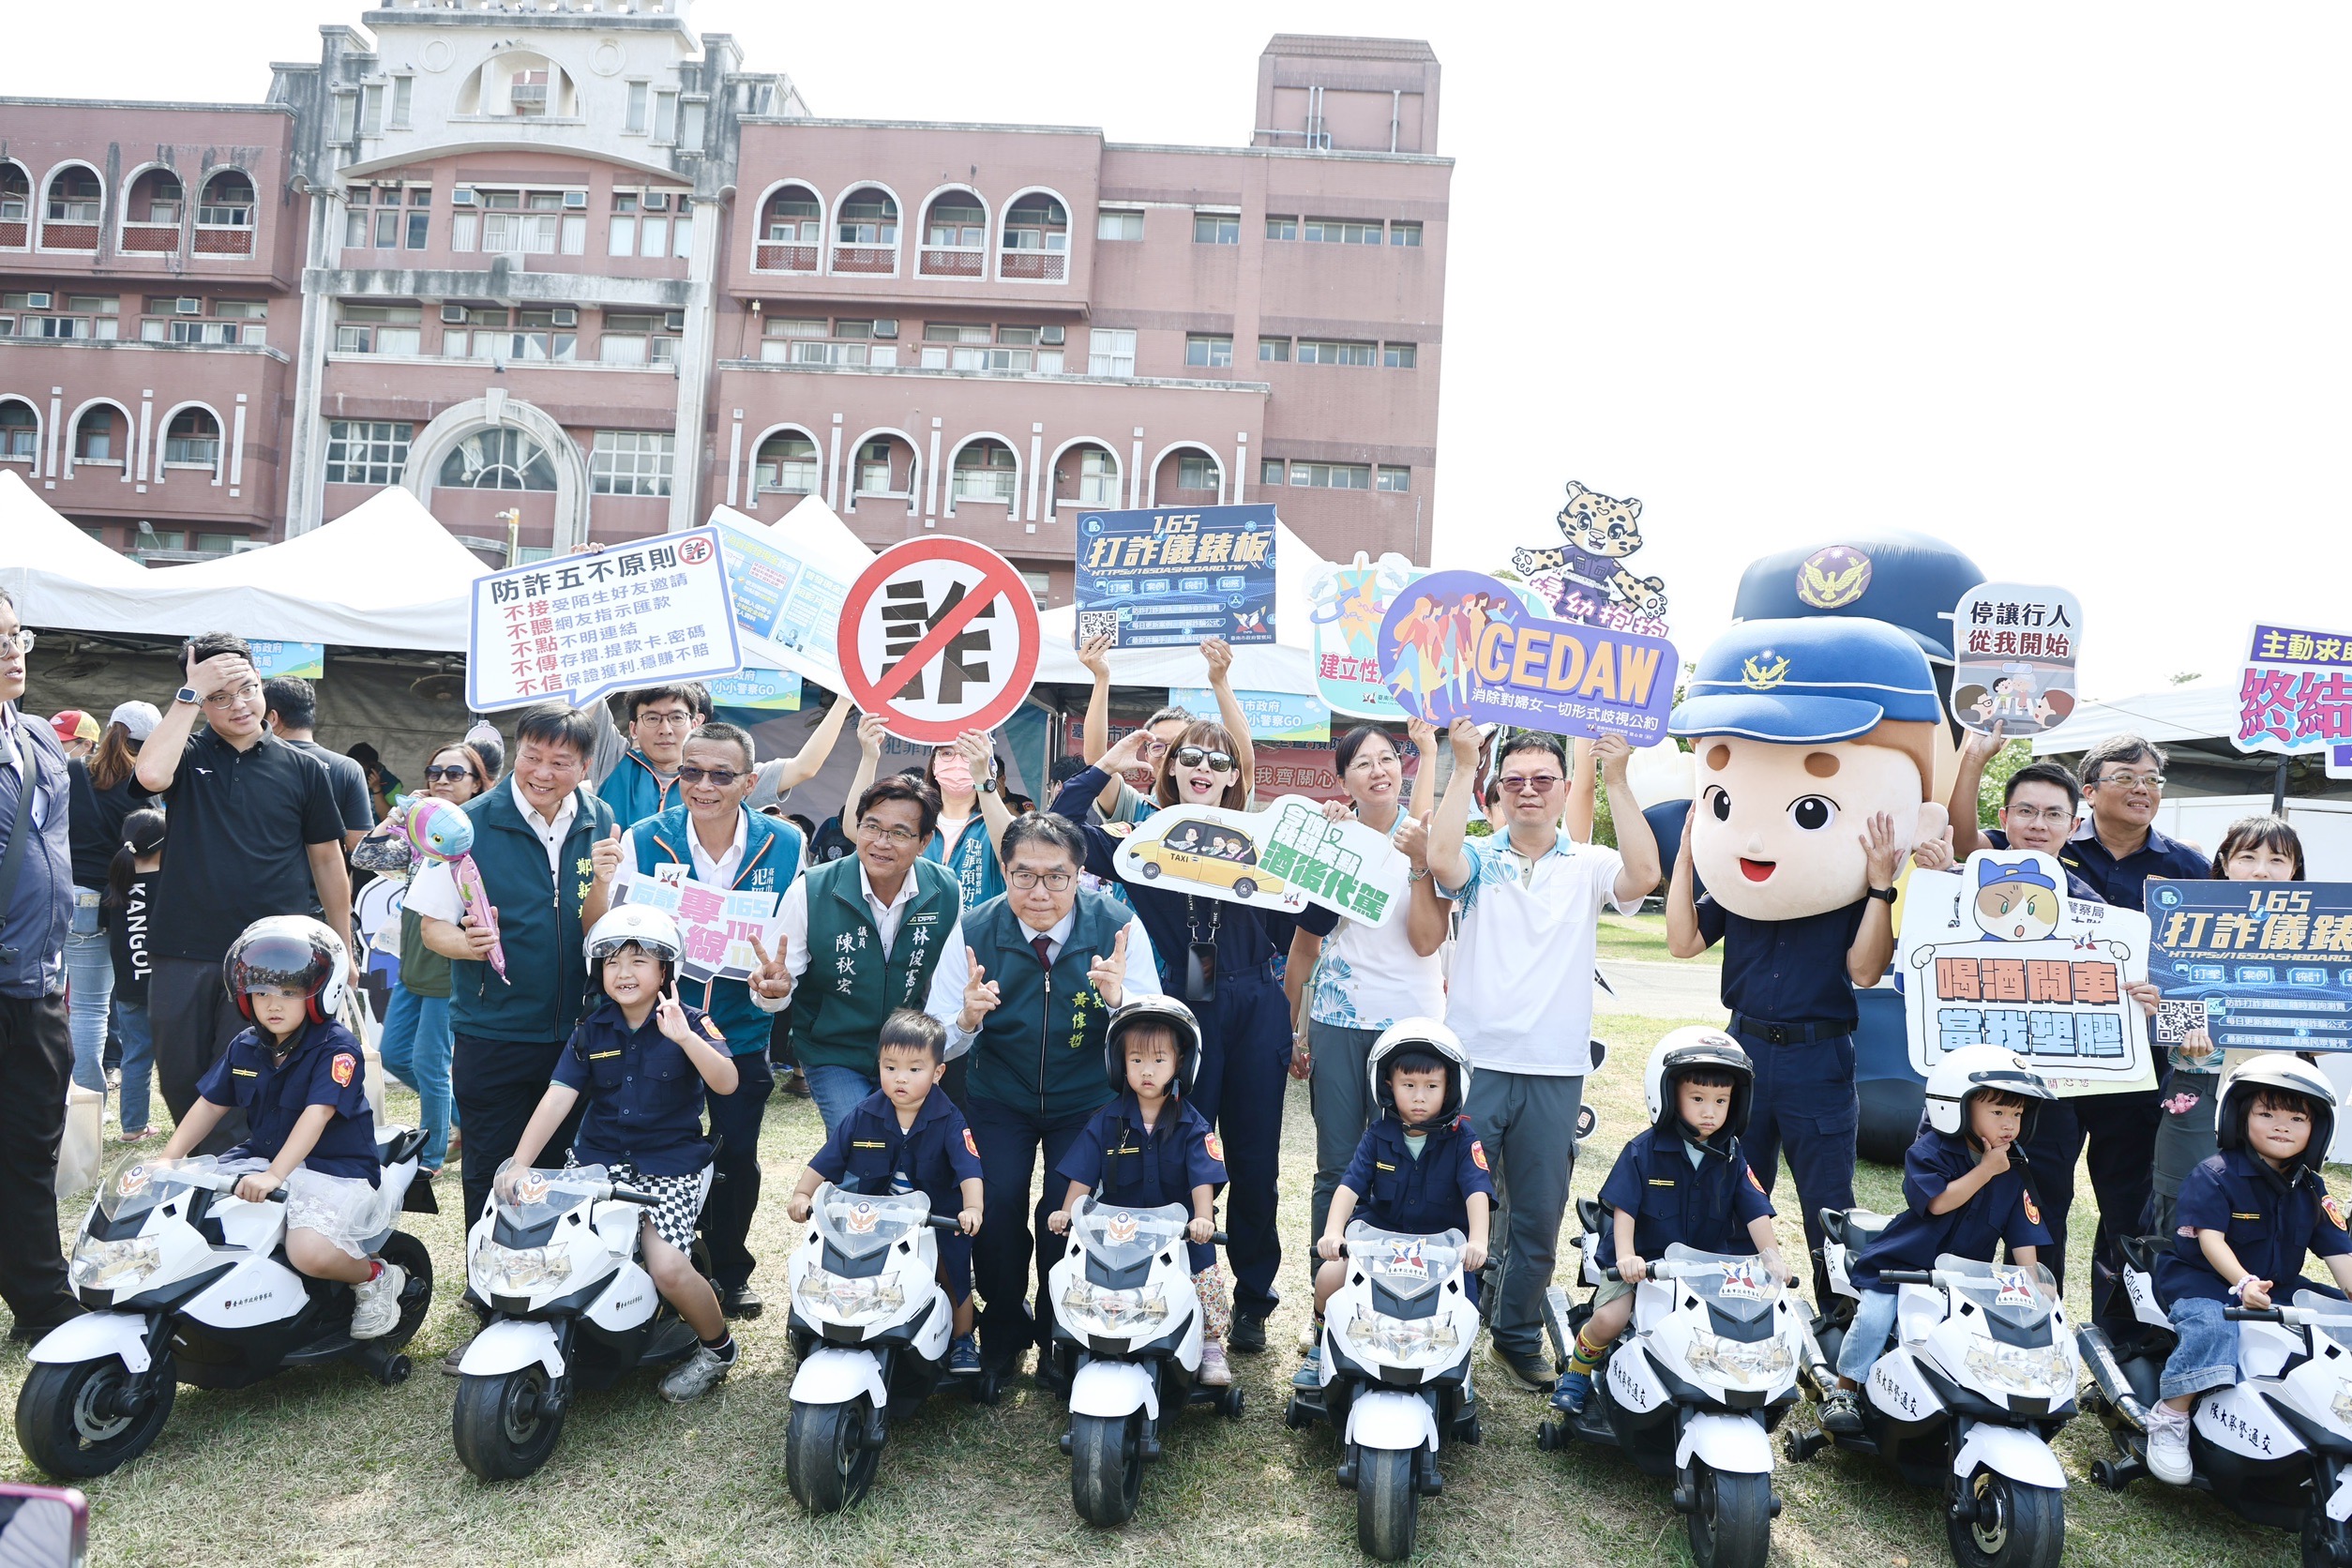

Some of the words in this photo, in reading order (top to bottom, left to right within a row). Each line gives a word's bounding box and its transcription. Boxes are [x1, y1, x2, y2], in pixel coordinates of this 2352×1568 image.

[1153, 515, 1201, 534] 165
[1088, 531, 1273, 568] 打詐儀錶板
[490, 545, 677, 604] 防詐五不原則
[504, 573, 689, 623] 不接受陌生好友邀請
[1970, 601, 2071, 628] 停讓行人
[506, 596, 672, 641] 不聽網友指示匯款
[511, 621, 638, 658] 不點不明連結
[881, 580, 996, 704] 詐
[1968, 629, 2070, 657] 從我開始
[1319, 654, 1385, 685] 建立性
[1478, 622, 1660, 705] CEDAW
[716, 682, 775, 695] 小小警察GO
[2239, 668, 2352, 742] 終結
[1247, 714, 1303, 728] 小警察GO
[1471, 687, 1659, 731] 消除對婦女一切形式歧視公約
[1256, 766, 1335, 788] 我齊關心
[1170, 852, 1189, 864] TAXI
[1258, 839, 1390, 923] 酒後代駕
[727, 895, 771, 919] 165
[2249, 890, 2313, 912] 165
[126, 882, 153, 981] KANGOL
[726, 919, 763, 942] 110
[857, 926, 868, 949] 議員
[836, 932, 857, 996] 陳秋宏
[1935, 957, 2120, 1006] 喝酒開車
[2194, 969, 2222, 980] 打擊
[2242, 970, 2269, 981] 案例
[2295, 971, 2321, 983] 統計
[1068, 991, 1091, 1048] 黃偉哲
[1937, 1008, 2125, 1058] 當我塑膠
[2124, 1269, 2144, 1306] POLICE
